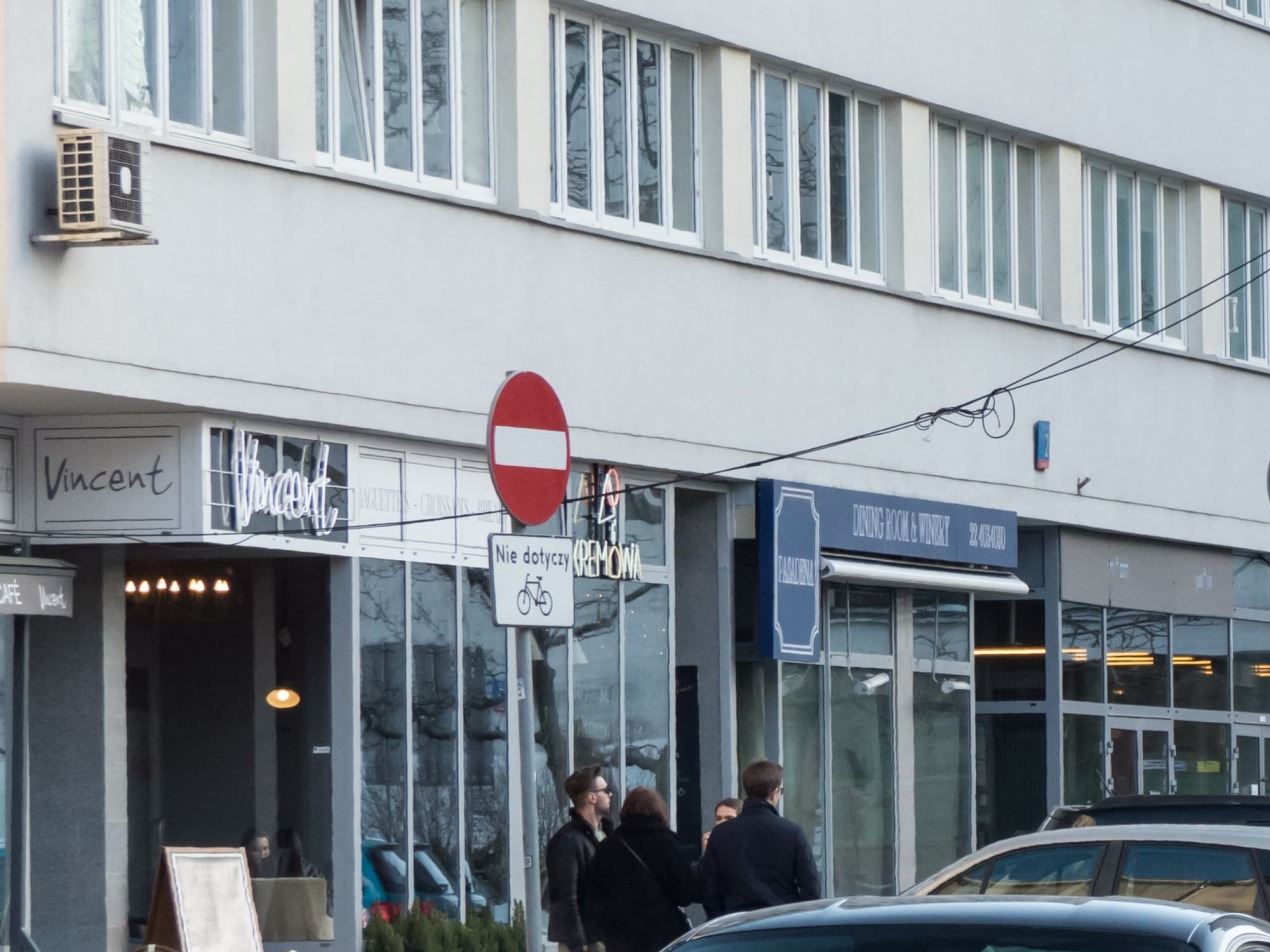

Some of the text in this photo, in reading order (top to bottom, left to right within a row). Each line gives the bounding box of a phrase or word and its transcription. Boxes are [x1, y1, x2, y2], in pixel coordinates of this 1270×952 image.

[44, 454, 173, 501] Vincent
[232, 428, 339, 537] Vincent
[853, 503, 884, 540] DINING
[885, 507, 909, 543] ROOM
[918, 512, 951, 548] WINERY
[496, 544, 570, 572] Nie dotyczy
